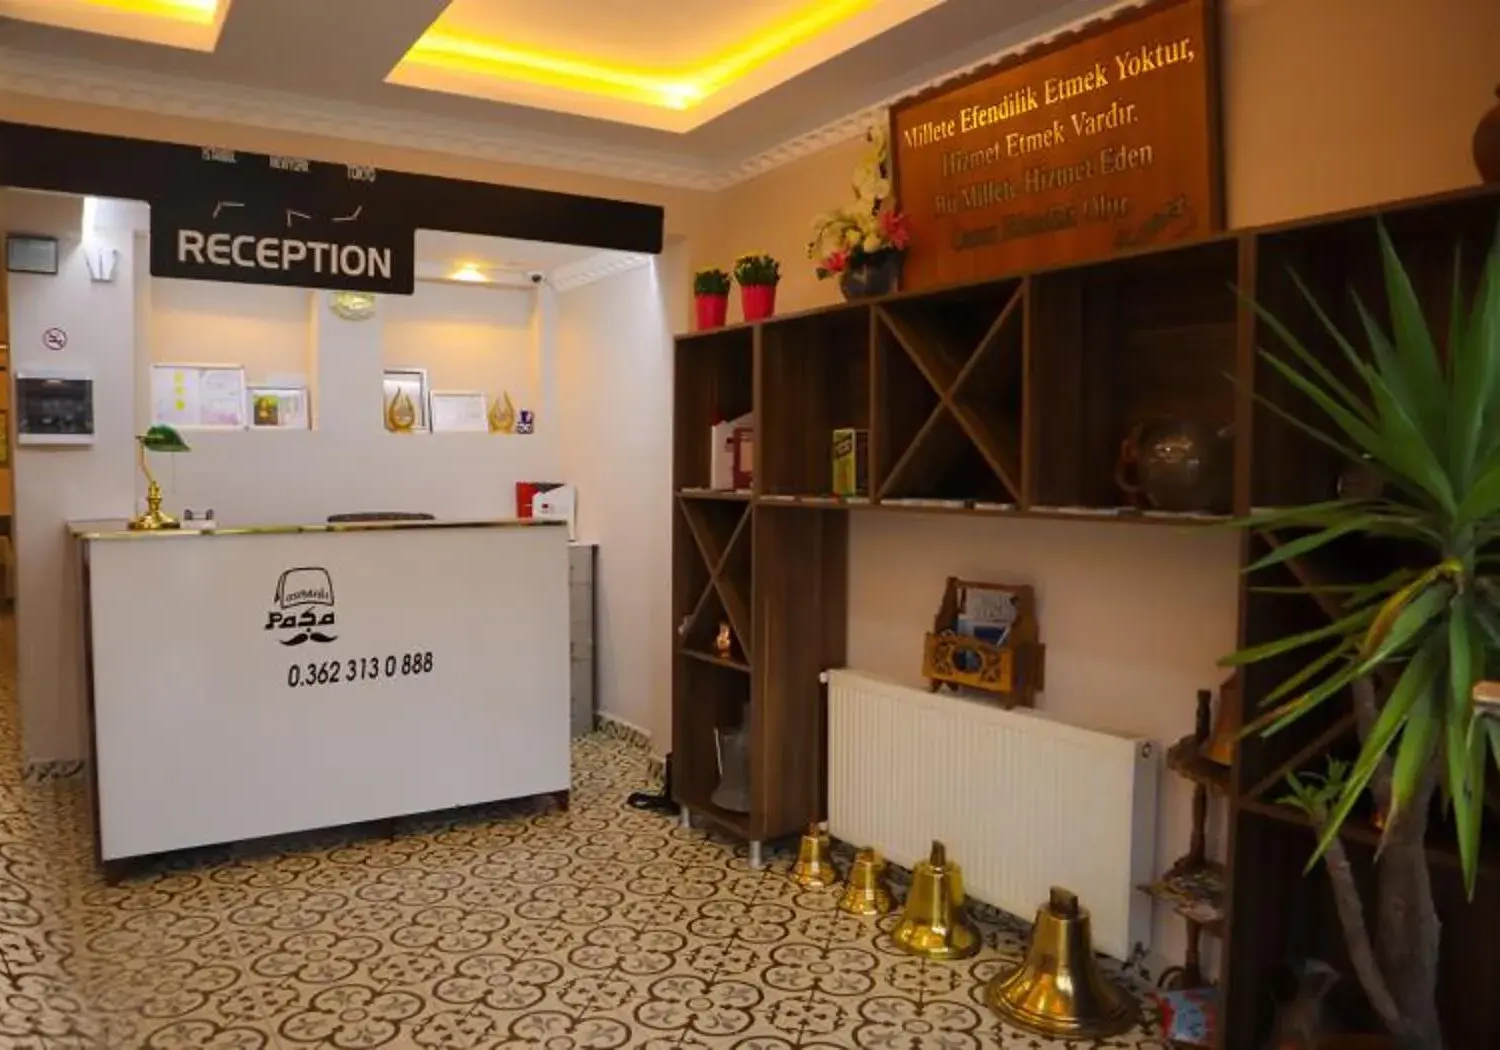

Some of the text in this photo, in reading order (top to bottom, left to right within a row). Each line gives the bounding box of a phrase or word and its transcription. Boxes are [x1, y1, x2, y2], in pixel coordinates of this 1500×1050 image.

[903, 37, 1195, 149] Millete Efendilik Etmek Yoktur,
[1005, 120, 1065, 157] Etmek
[1070, 101, 1139, 138] Vardır.
[1100, 144, 1154, 175] Eden
[177, 228, 392, 279] RECEPTION
[288, 652, 433, 688] 0.362 313 0 888
